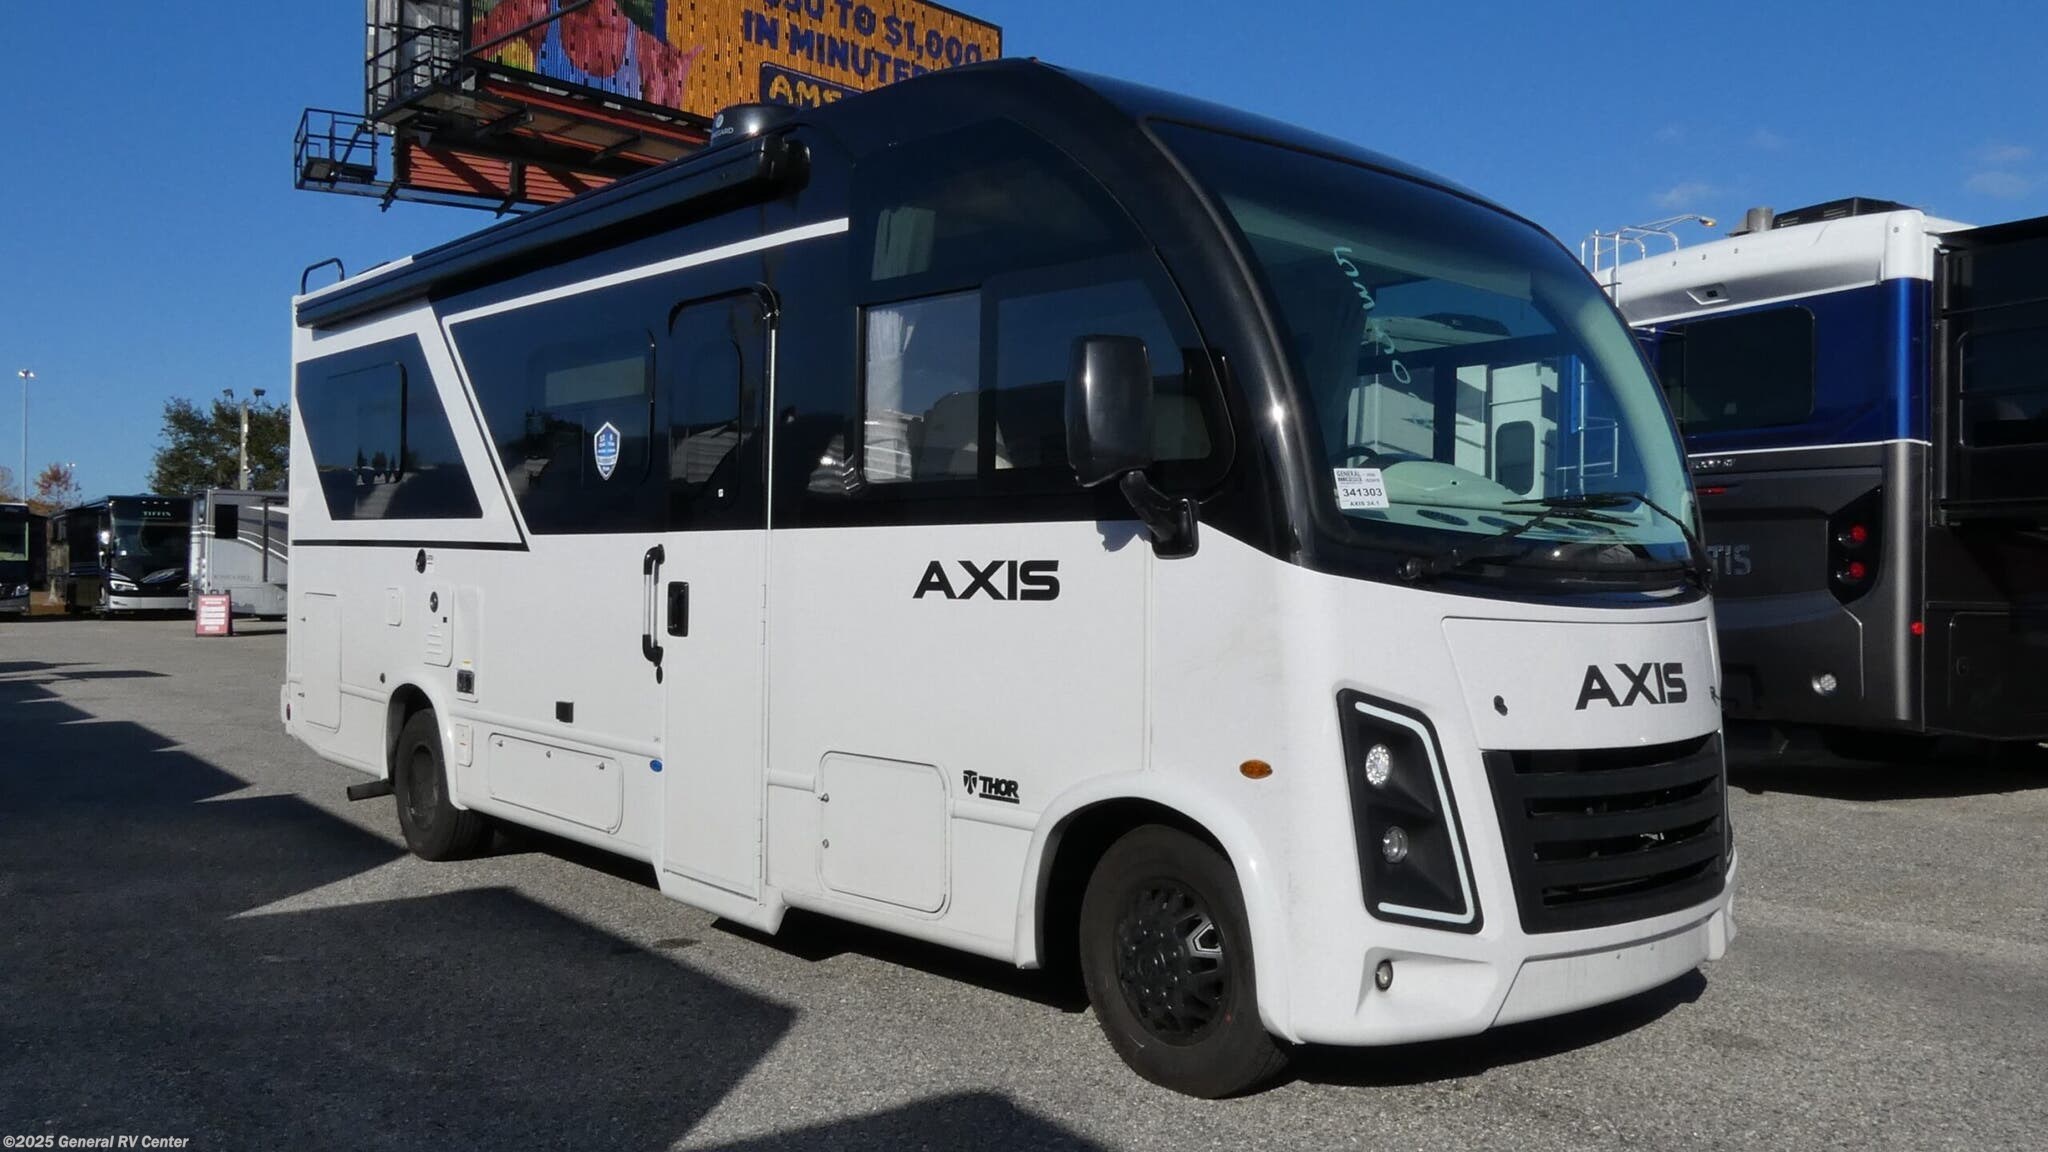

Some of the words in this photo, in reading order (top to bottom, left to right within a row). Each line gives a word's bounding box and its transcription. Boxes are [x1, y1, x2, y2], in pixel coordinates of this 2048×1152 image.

[743, 9, 779, 49] IN
[1342, 488, 1383, 497] 341303
[912, 560, 1060, 601] AXIS
[1575, 662, 1688, 711] AXIS
[979, 775, 1019, 799] THOR
